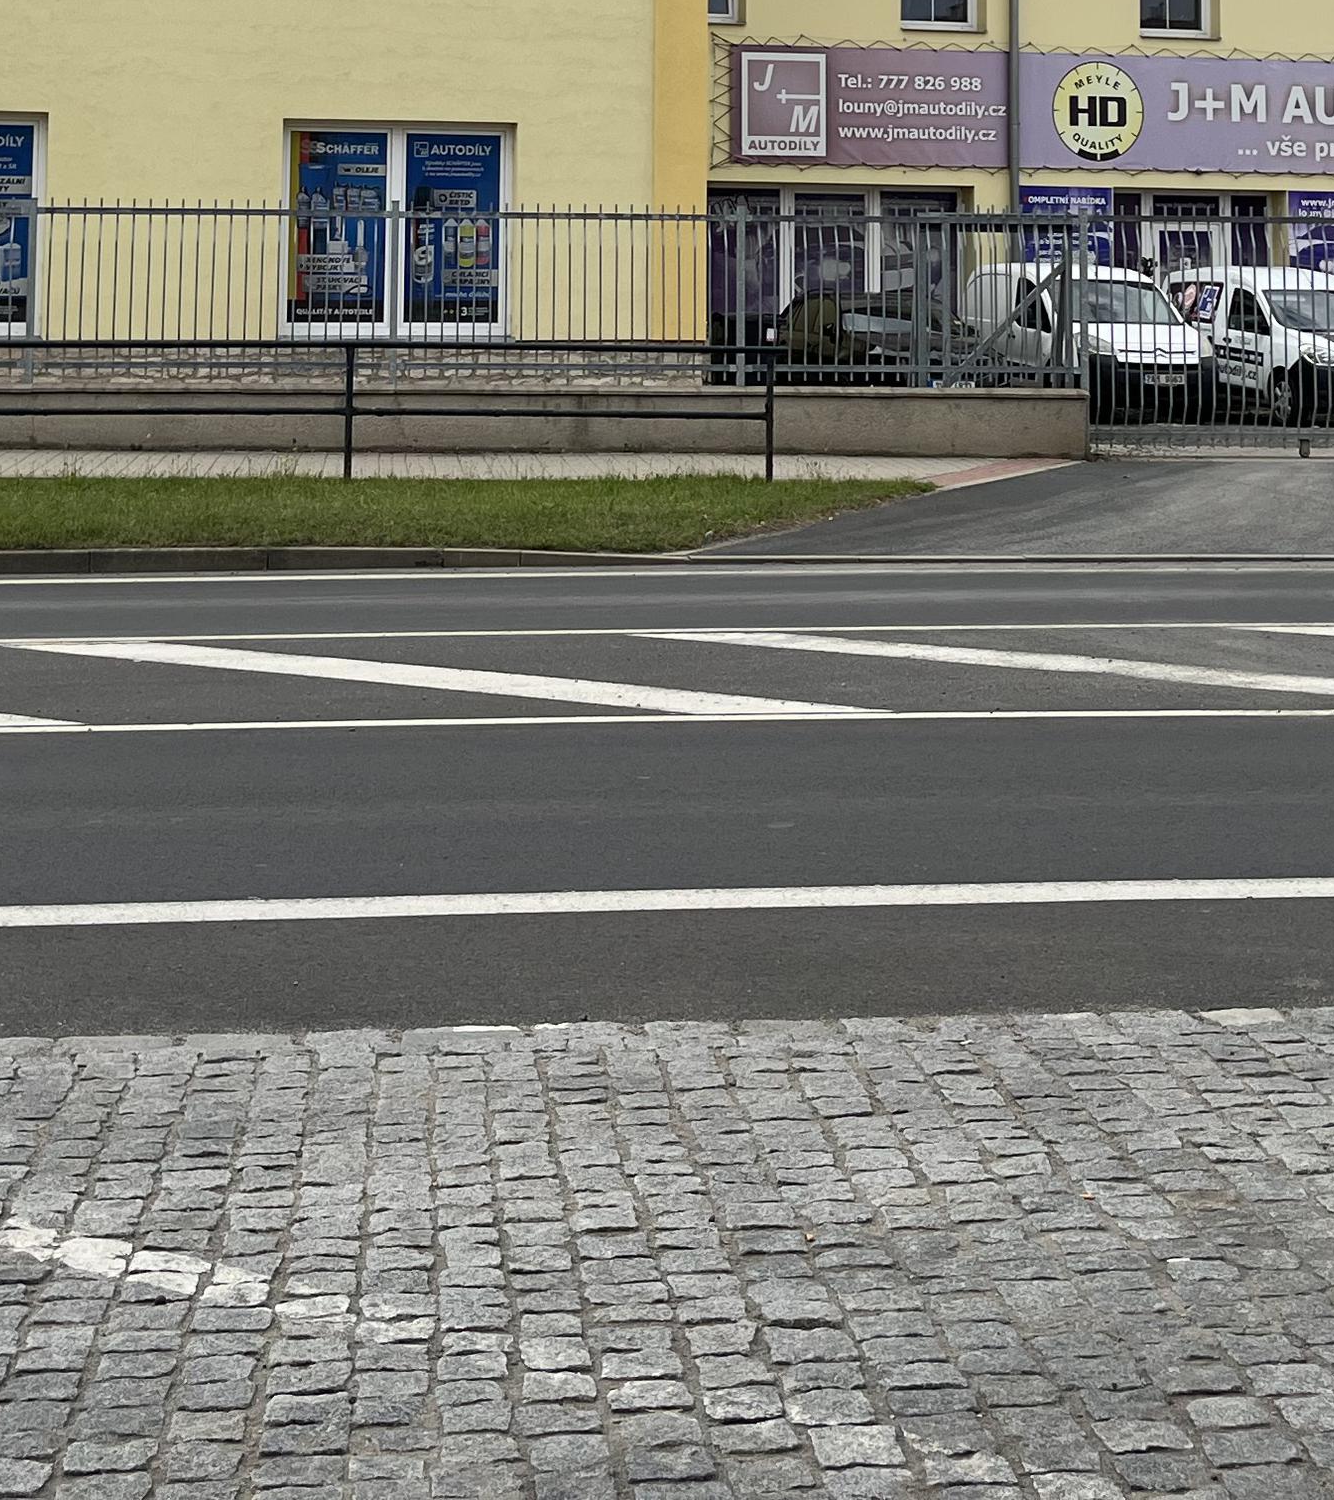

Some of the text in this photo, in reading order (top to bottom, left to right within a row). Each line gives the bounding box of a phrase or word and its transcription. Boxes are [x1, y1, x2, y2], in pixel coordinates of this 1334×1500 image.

[838, 74, 982, 91] Tel.: 777 826 988
[1074, 75, 1121, 90] MEYLE
[839, 99, 1007, 118] louny@jmautodily.cz
[1069, 95, 1127, 127] HD
[1167, 82, 1267, 123] J+M
[838, 125, 997, 143] www.jmautodily.cz
[1072, 133, 1123, 150] QUALITY
[431, 144, 492, 156] AUTODÍLY
[748, 138, 820, 151] AUTODÍLY
[1267, 135, 1307, 156] vše
[1022, 194, 1069, 205] OMPLETNÍ
